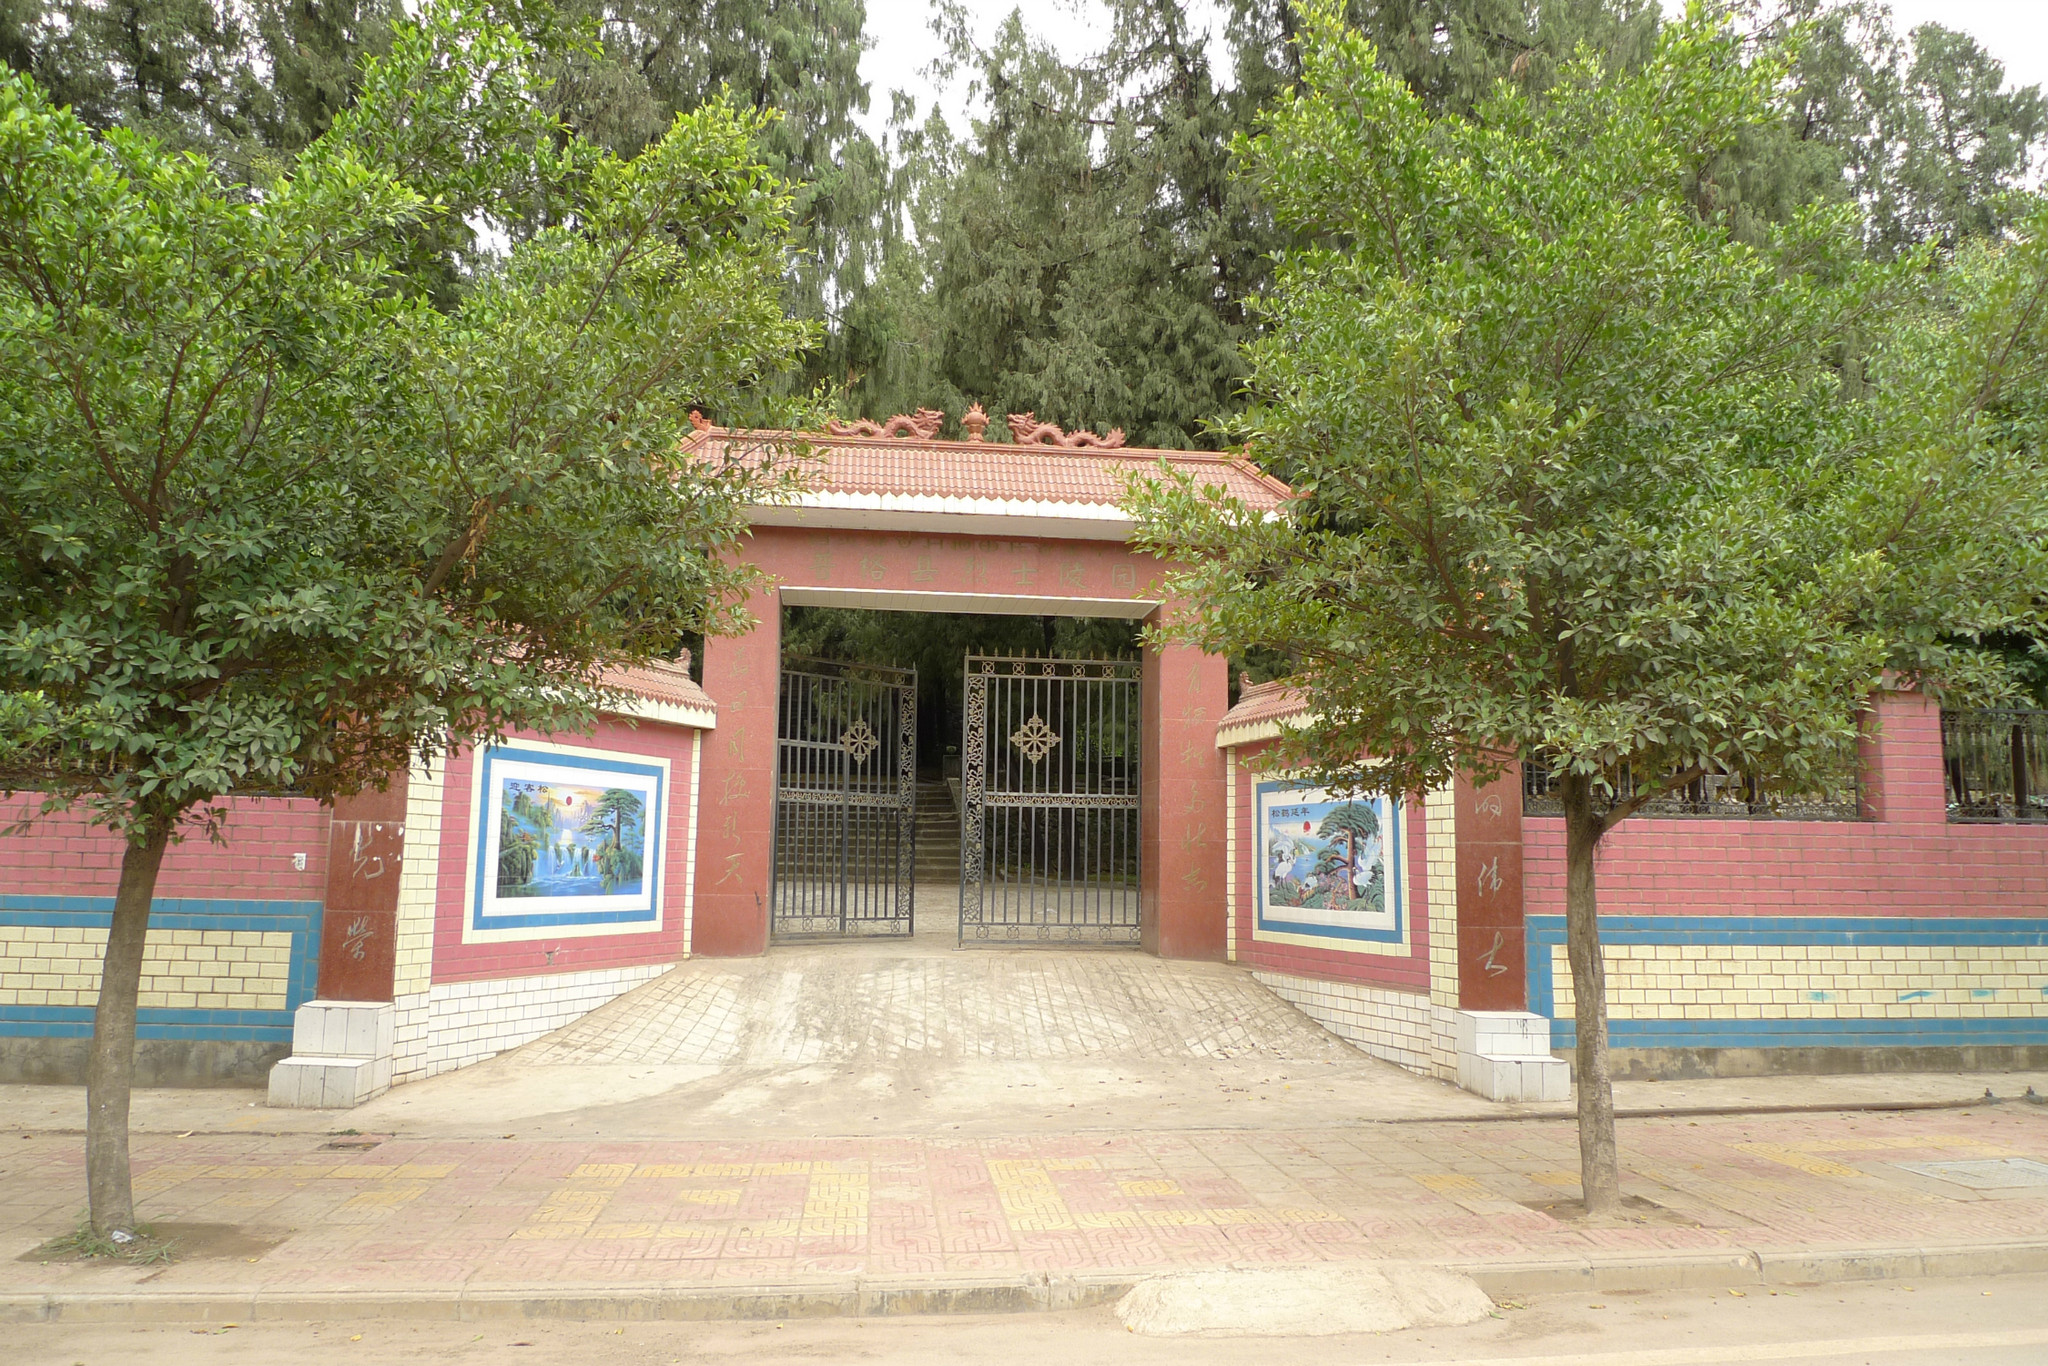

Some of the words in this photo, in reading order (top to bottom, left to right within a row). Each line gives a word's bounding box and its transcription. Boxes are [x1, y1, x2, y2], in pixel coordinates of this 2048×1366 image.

[808, 552, 1137, 590] 普格县烈士陵园
[509, 781, 549, 794] 迎客松
[1271, 806, 1310, 818] 松鹤延年
